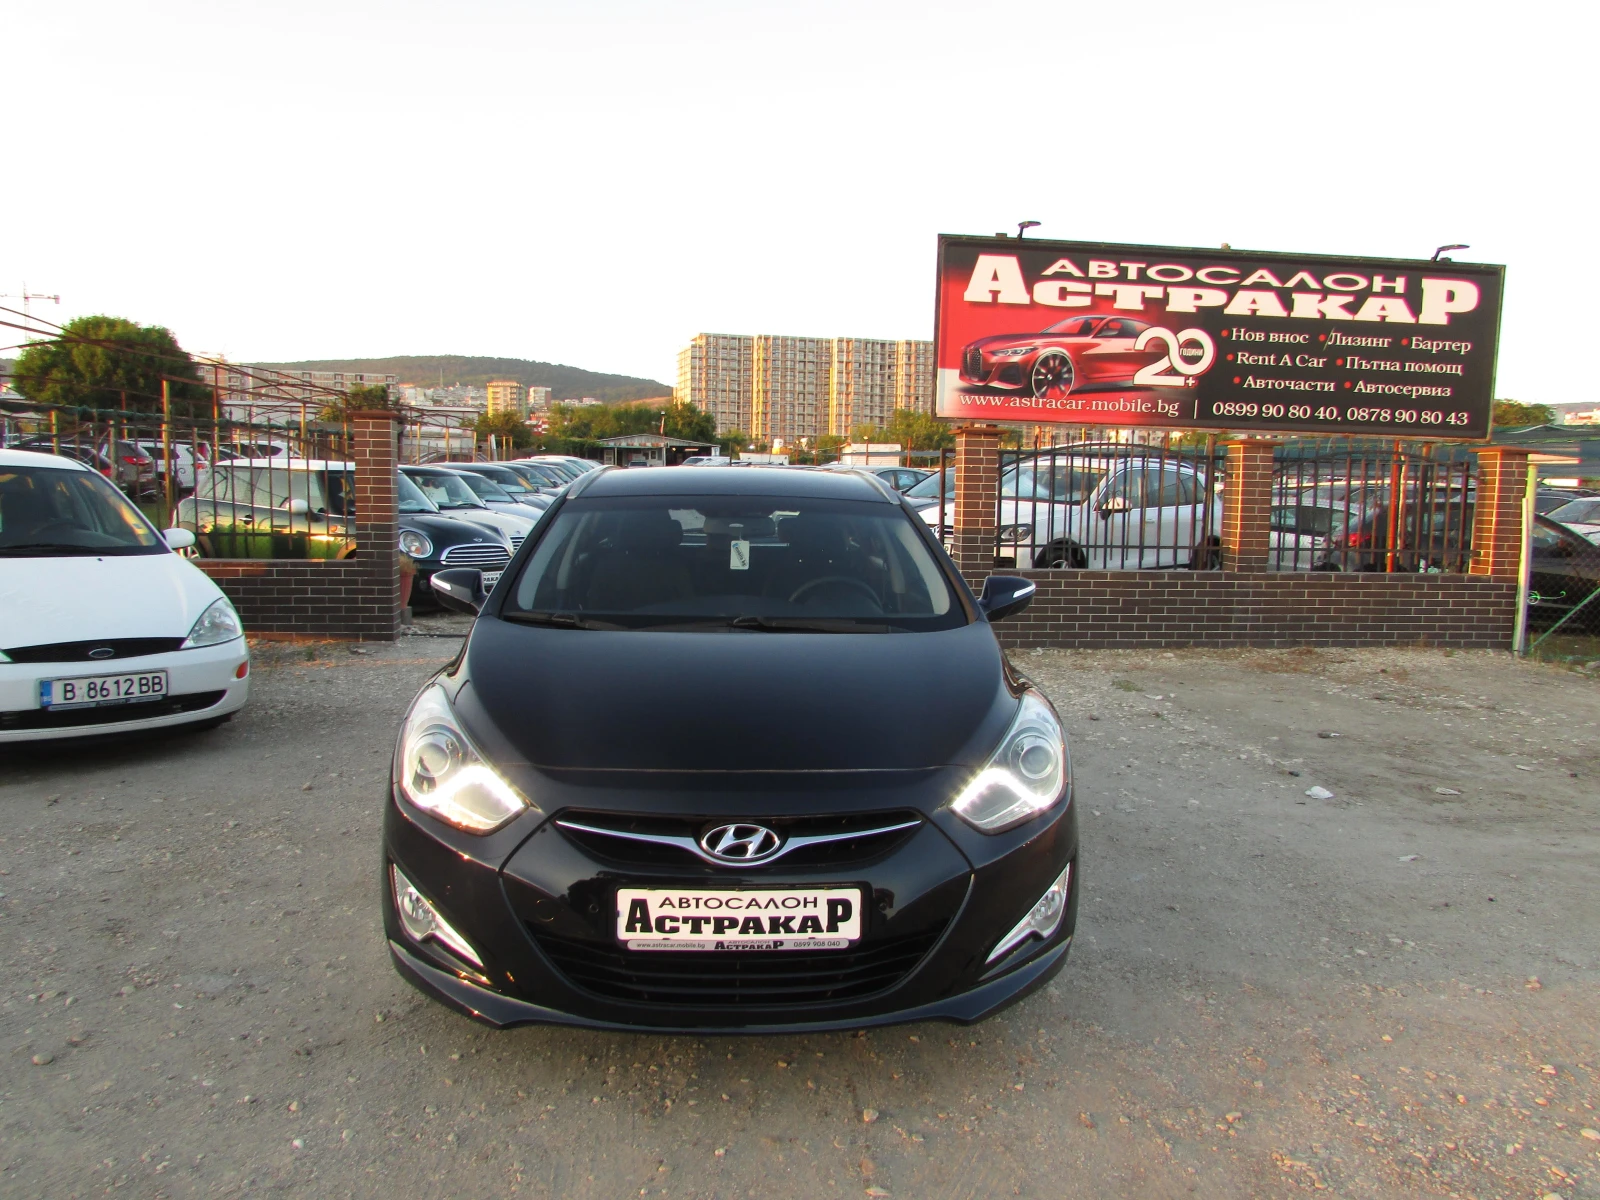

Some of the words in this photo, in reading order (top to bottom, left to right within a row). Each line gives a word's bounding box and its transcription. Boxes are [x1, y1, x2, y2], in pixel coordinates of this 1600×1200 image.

[1041, 258, 1408, 294] АВТОСАЛОН
[1231, 327, 1265, 342] Нов
[1268, 331, 1310, 345] внос
[1328, 332, 1392, 348] Лизинг
[1410, 336, 1472, 355] Бартер
[1236, 352, 1276, 367] Rent
[1278, 353, 1293, 367] A
[1295, 353, 1327, 368] Car
[1345, 356, 1401, 372] Пътна
[1404, 361, 1463, 376] помощ
[1243, 375, 1336, 392] Авточасти
[1353, 380, 1452, 398] Автосервиз
[959, 393, 1180, 417] www.astracar.mobile.bg
[1212, 401, 1258, 417] 0899
[1261, 403, 1285, 418] 90
[1288, 404, 1311, 420] 80
[1347, 407, 1391, 423] 0878
[1394, 408, 1417, 424] 90
[1420, 409, 1443, 425] 80
[1446, 411, 1469, 426] 43
[87, 677, 135, 700] 8612
[658, 896, 818, 910] АВТОСАЛОН
[636, 942, 706, 950] www.astracar.mobile.bg
